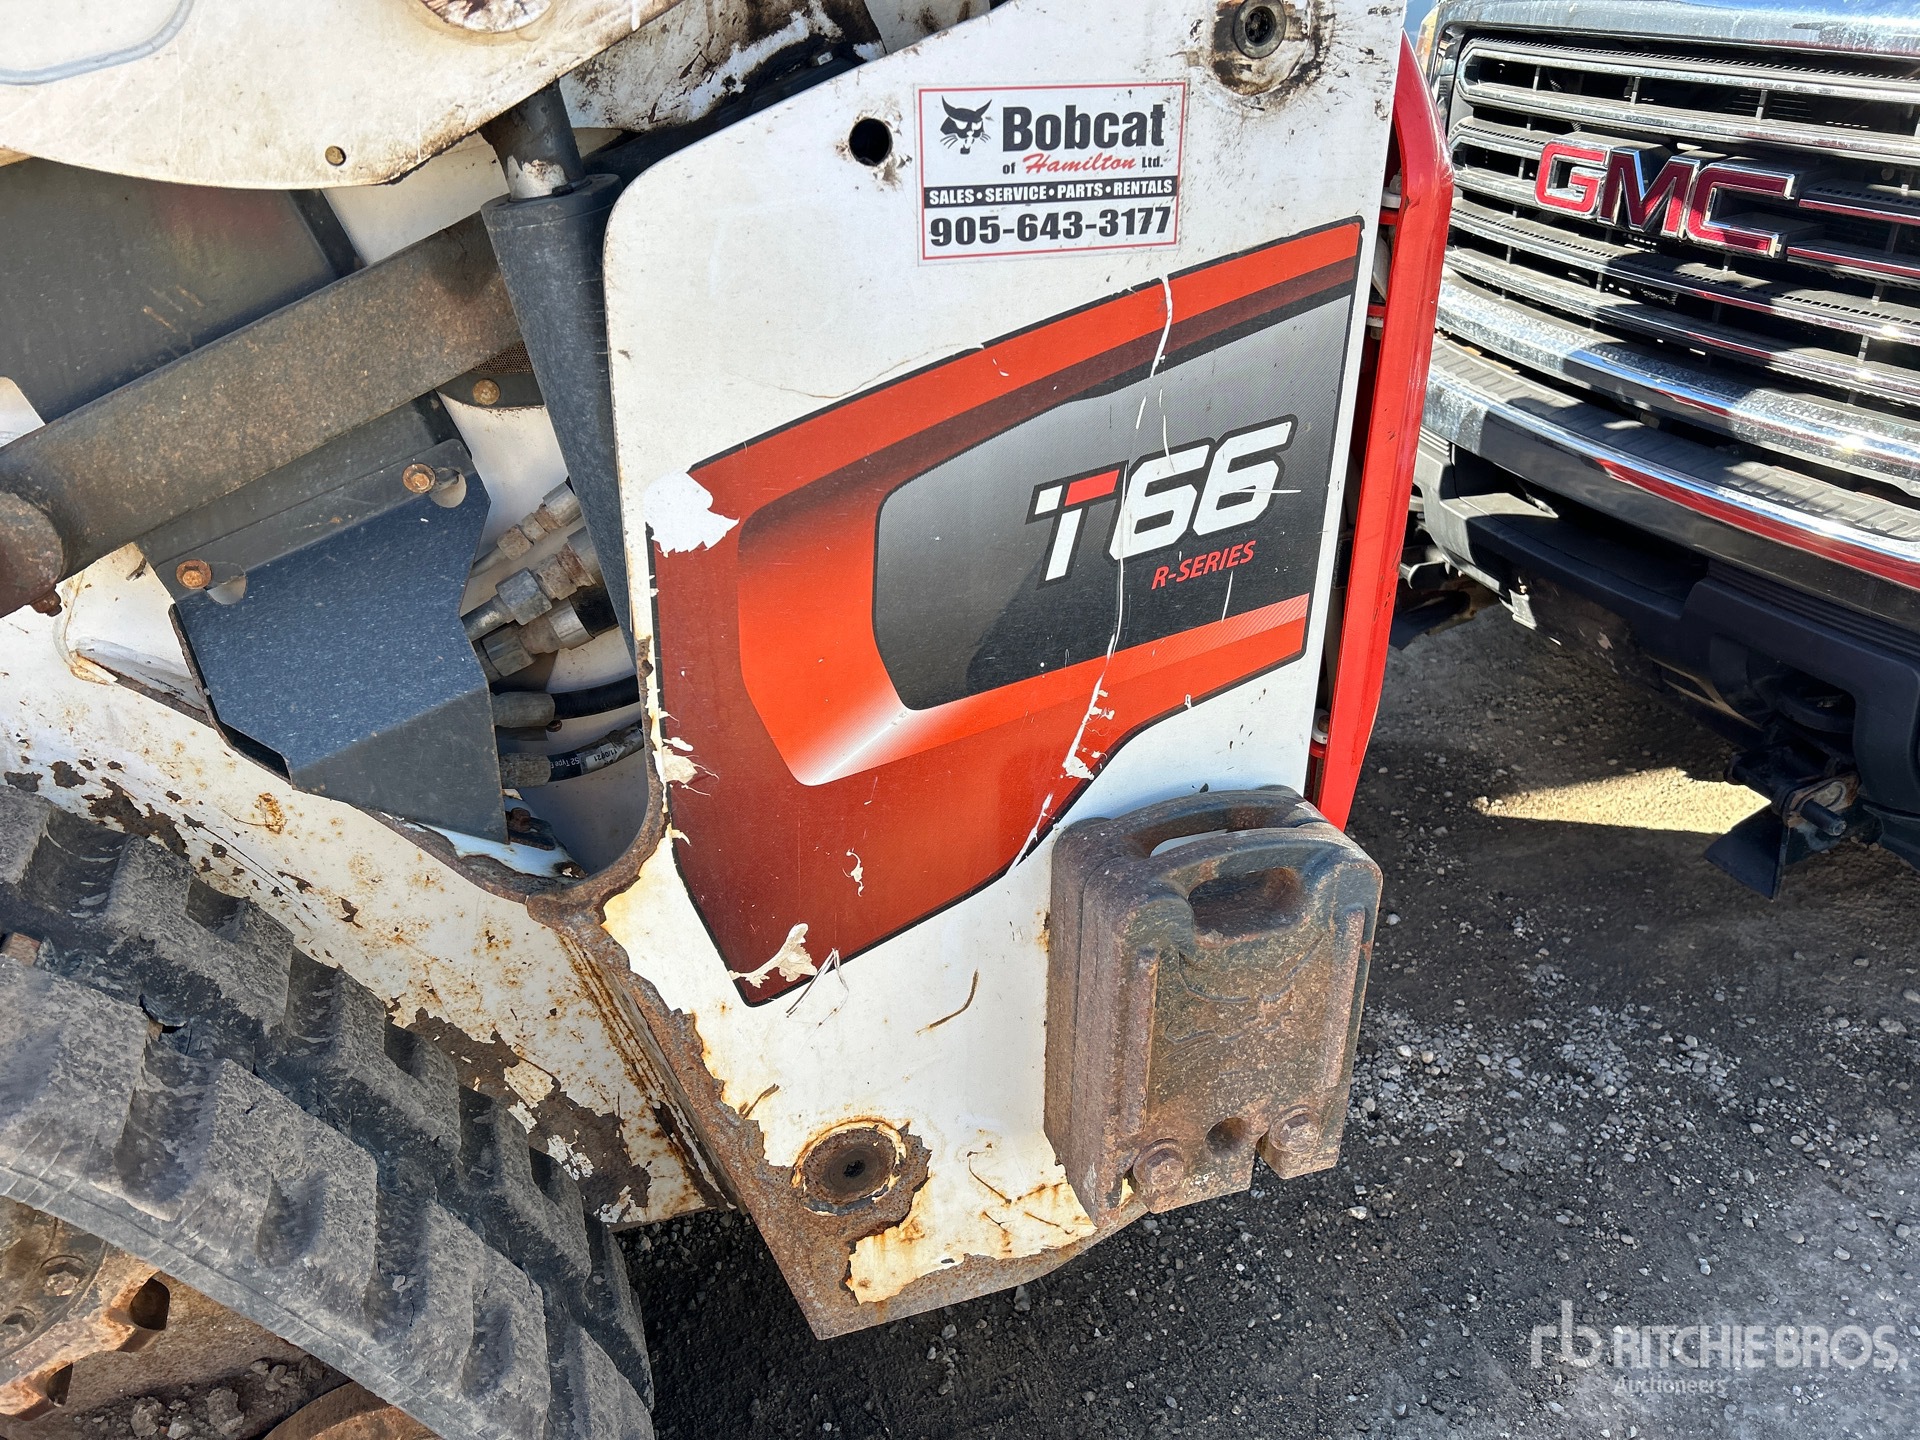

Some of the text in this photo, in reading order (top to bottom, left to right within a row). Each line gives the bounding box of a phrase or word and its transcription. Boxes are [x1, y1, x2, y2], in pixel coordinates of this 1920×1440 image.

[1002, 104, 1166, 152] Bobcat
[1002, 152, 1164, 175] of Hamilton Ltd.
[929, 179, 1173, 205] SALES SERVICE PARTS RENTALS
[1534, 140, 1796, 258] GMC
[930, 206, 1171, 247] 905-643-3177
[1032, 419, 1293, 582] T66
[1151, 540, 1257, 590] R-SERIES
